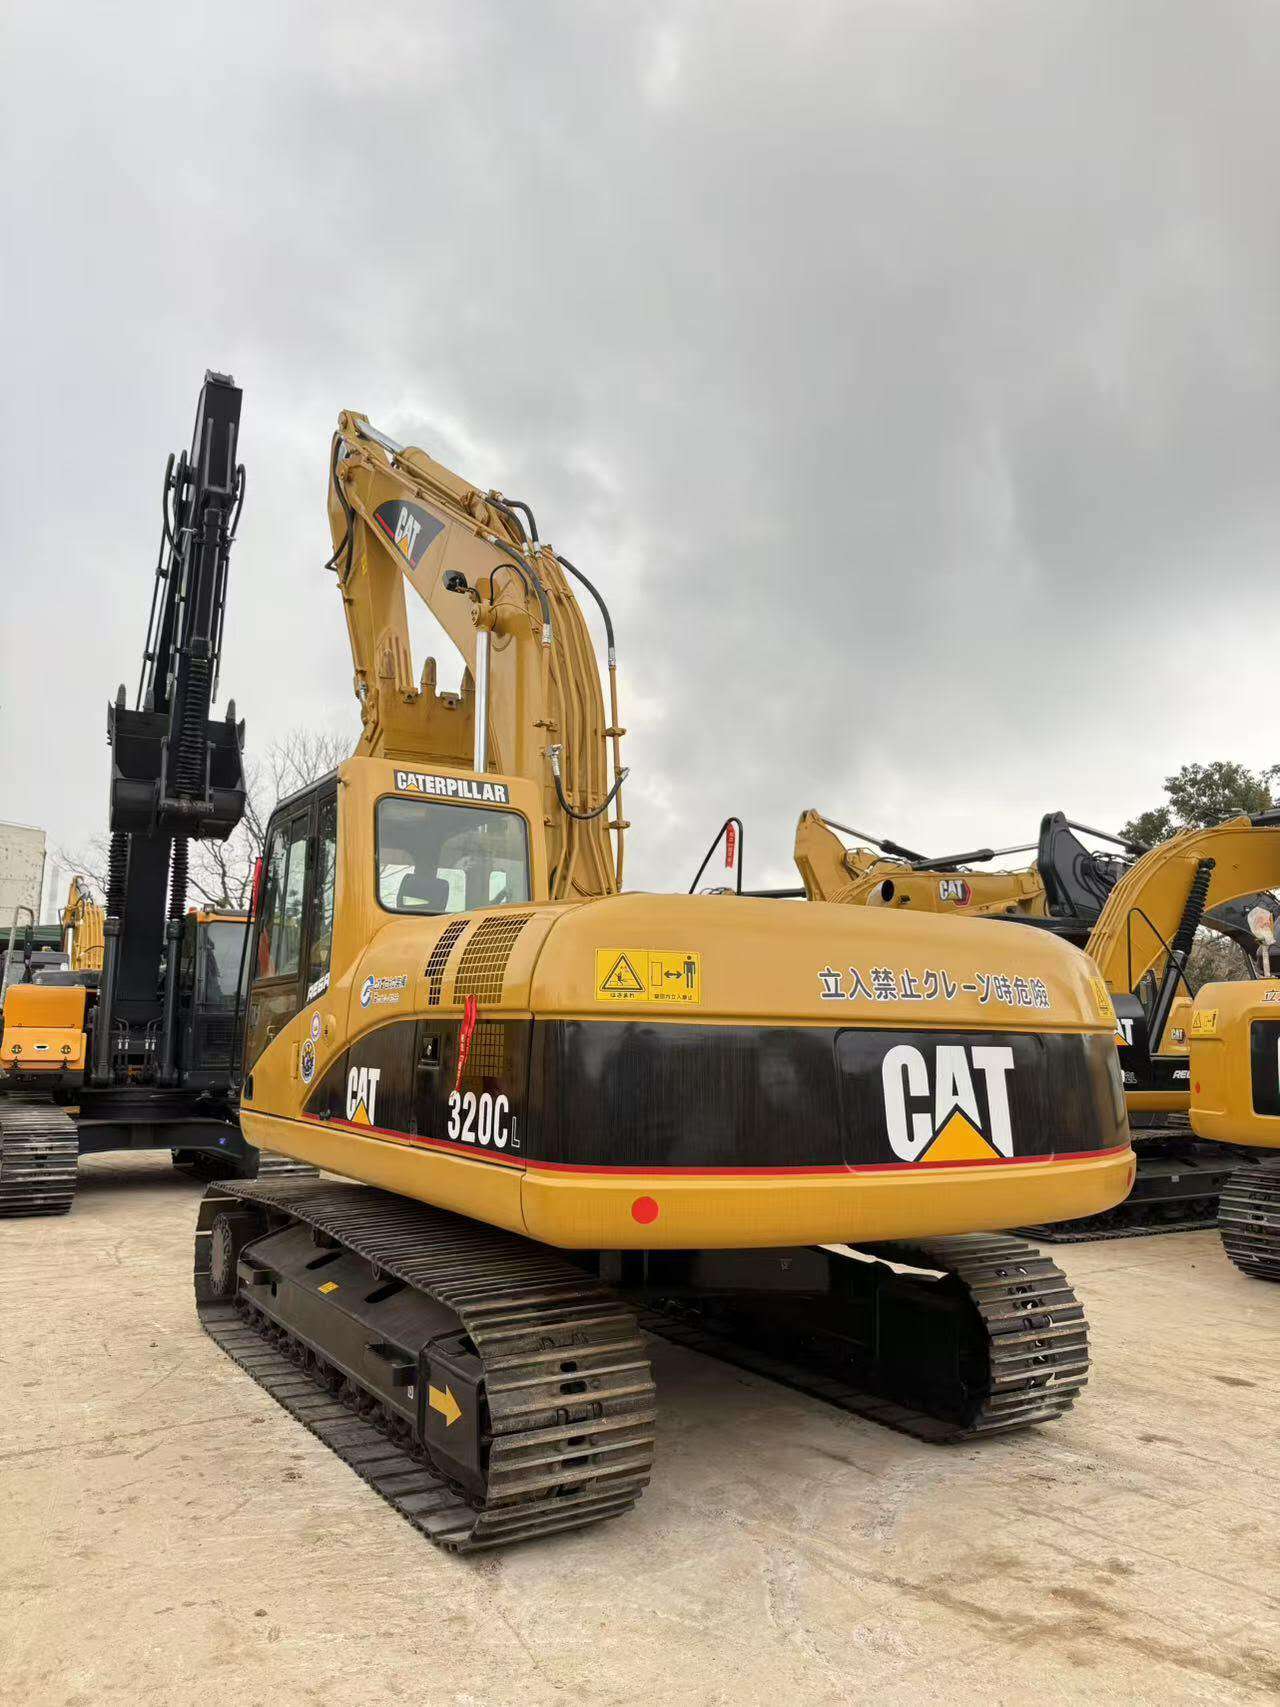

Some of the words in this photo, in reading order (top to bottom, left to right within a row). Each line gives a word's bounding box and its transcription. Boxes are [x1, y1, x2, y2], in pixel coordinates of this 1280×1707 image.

[394, 507, 421, 561] CAT
[397, 771, 506, 803] CATERPILLAR
[940, 880, 963, 900] CAT
[1171, 1028, 1183, 1041] CAT
[346, 1066, 381, 1126] CAT
[447, 1089, 509, 1148] 320C
[882, 1044, 1015, 1162] CAT
